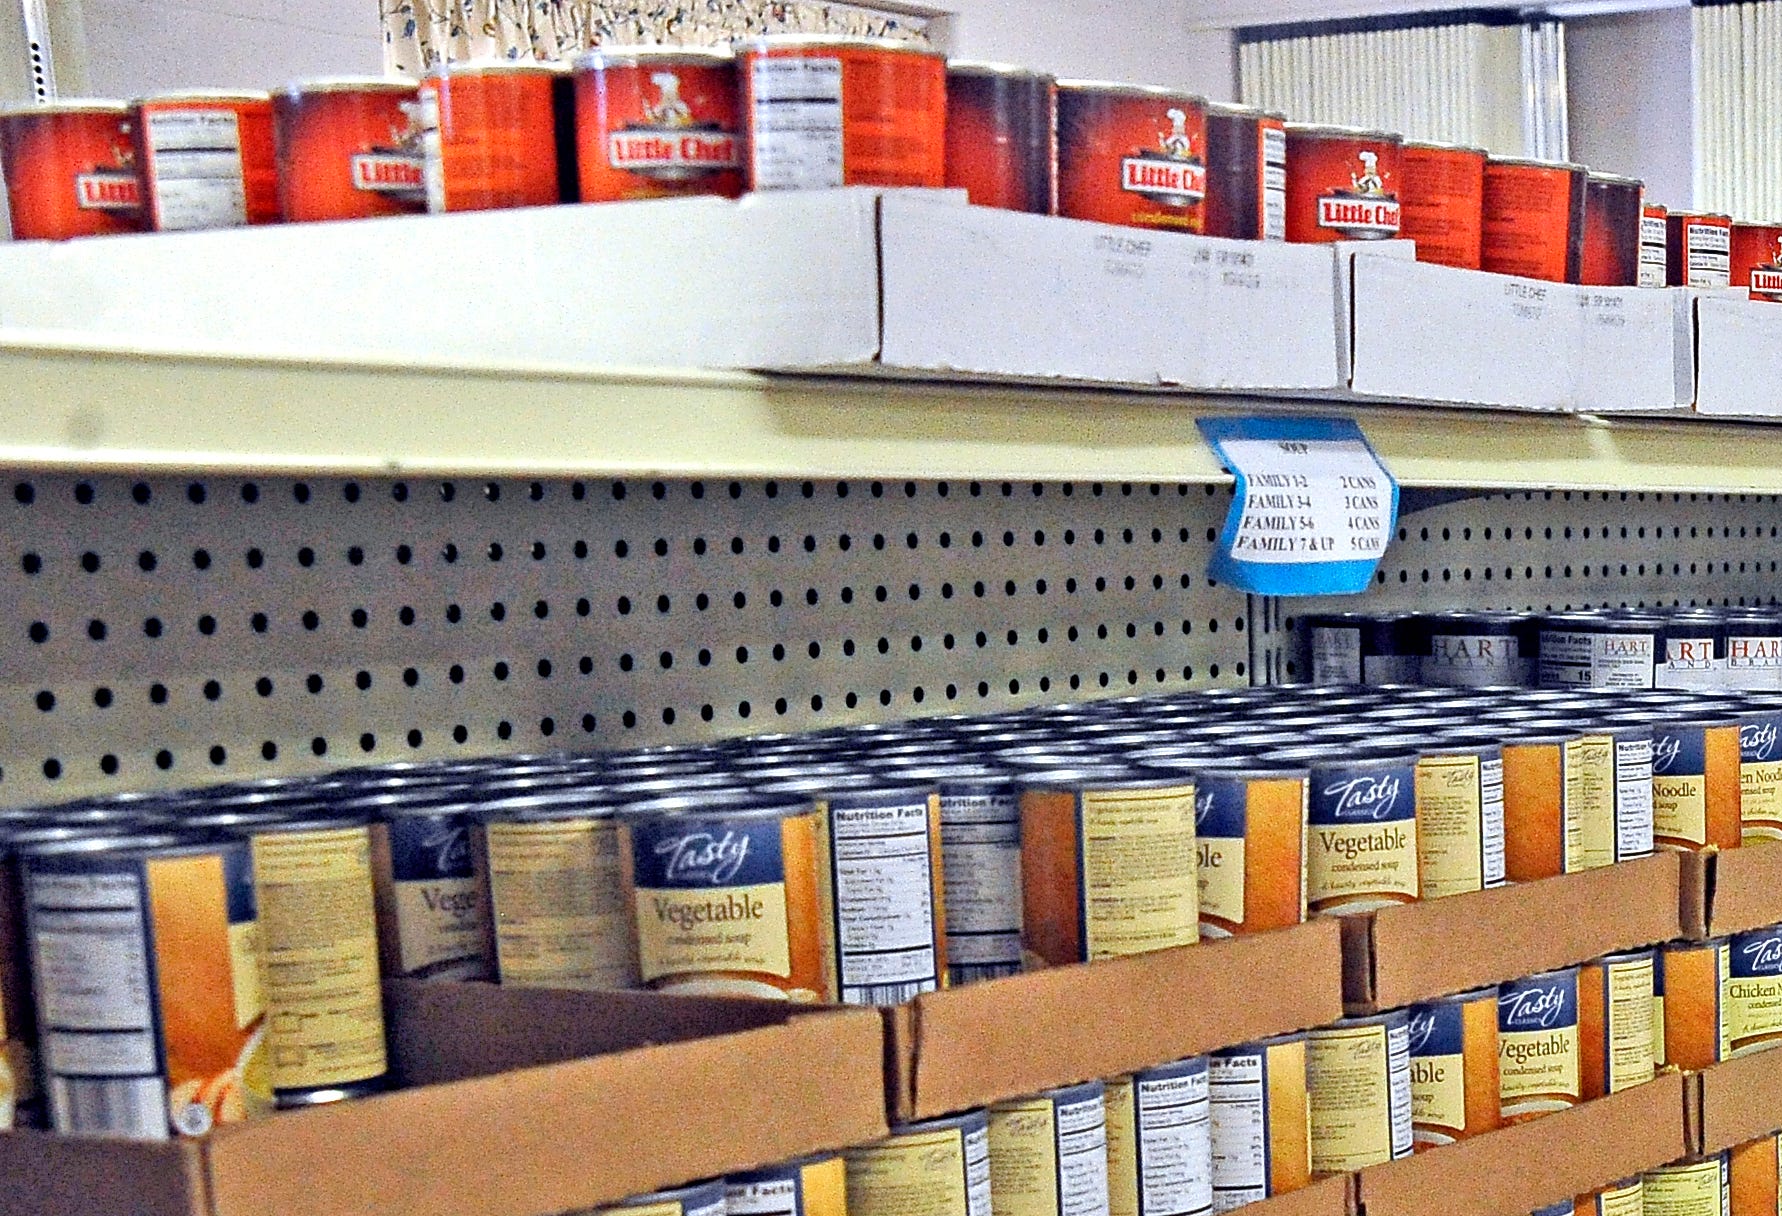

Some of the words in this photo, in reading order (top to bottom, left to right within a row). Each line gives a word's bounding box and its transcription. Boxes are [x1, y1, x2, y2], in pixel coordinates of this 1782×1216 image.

[1128, 163, 1179, 188] Little
[1323, 201, 1372, 224] Little
[1248, 473, 1290, 488] FAMILY
[1293, 474, 1308, 488] 1-2
[1339, 476, 1347, 488] 2
[1349, 477, 1376, 489] CANS
[1249, 494, 1294, 509] FAMILY
[1297, 495, 1311, 509] 3-4
[1352, 496, 1378, 510] CANS
[1242, 515, 1297, 530] FAMILY
[1300, 516, 1314, 530] 5-6
[1355, 516, 1379, 530] CANS
[1237, 536, 1299, 551] FAMILY
[1300, 538, 1307, 550] 7
[1309, 538, 1318, 551] &
[1321, 537, 1335, 551] UP
[1605, 640, 1648, 651] HART
[1731, 639, 1780, 658] HAR
[1578, 671, 1591, 681] 15
[1324, 775, 1399, 819] Tasty
[1653, 783, 1696, 798] Noodle
[836, 810, 893, 822] Nutrition
[1319, 827, 1407, 859] Vegetable
[655, 831, 750, 883] Tasty
[1331, 860, 1379, 872] condensed
[653, 894, 764, 930] Vegetable
[1730, 983, 1776, 999] Chicken
[1499, 985, 1566, 1027] Tasty
[1140, 1077, 1187, 1094] Nutrition
